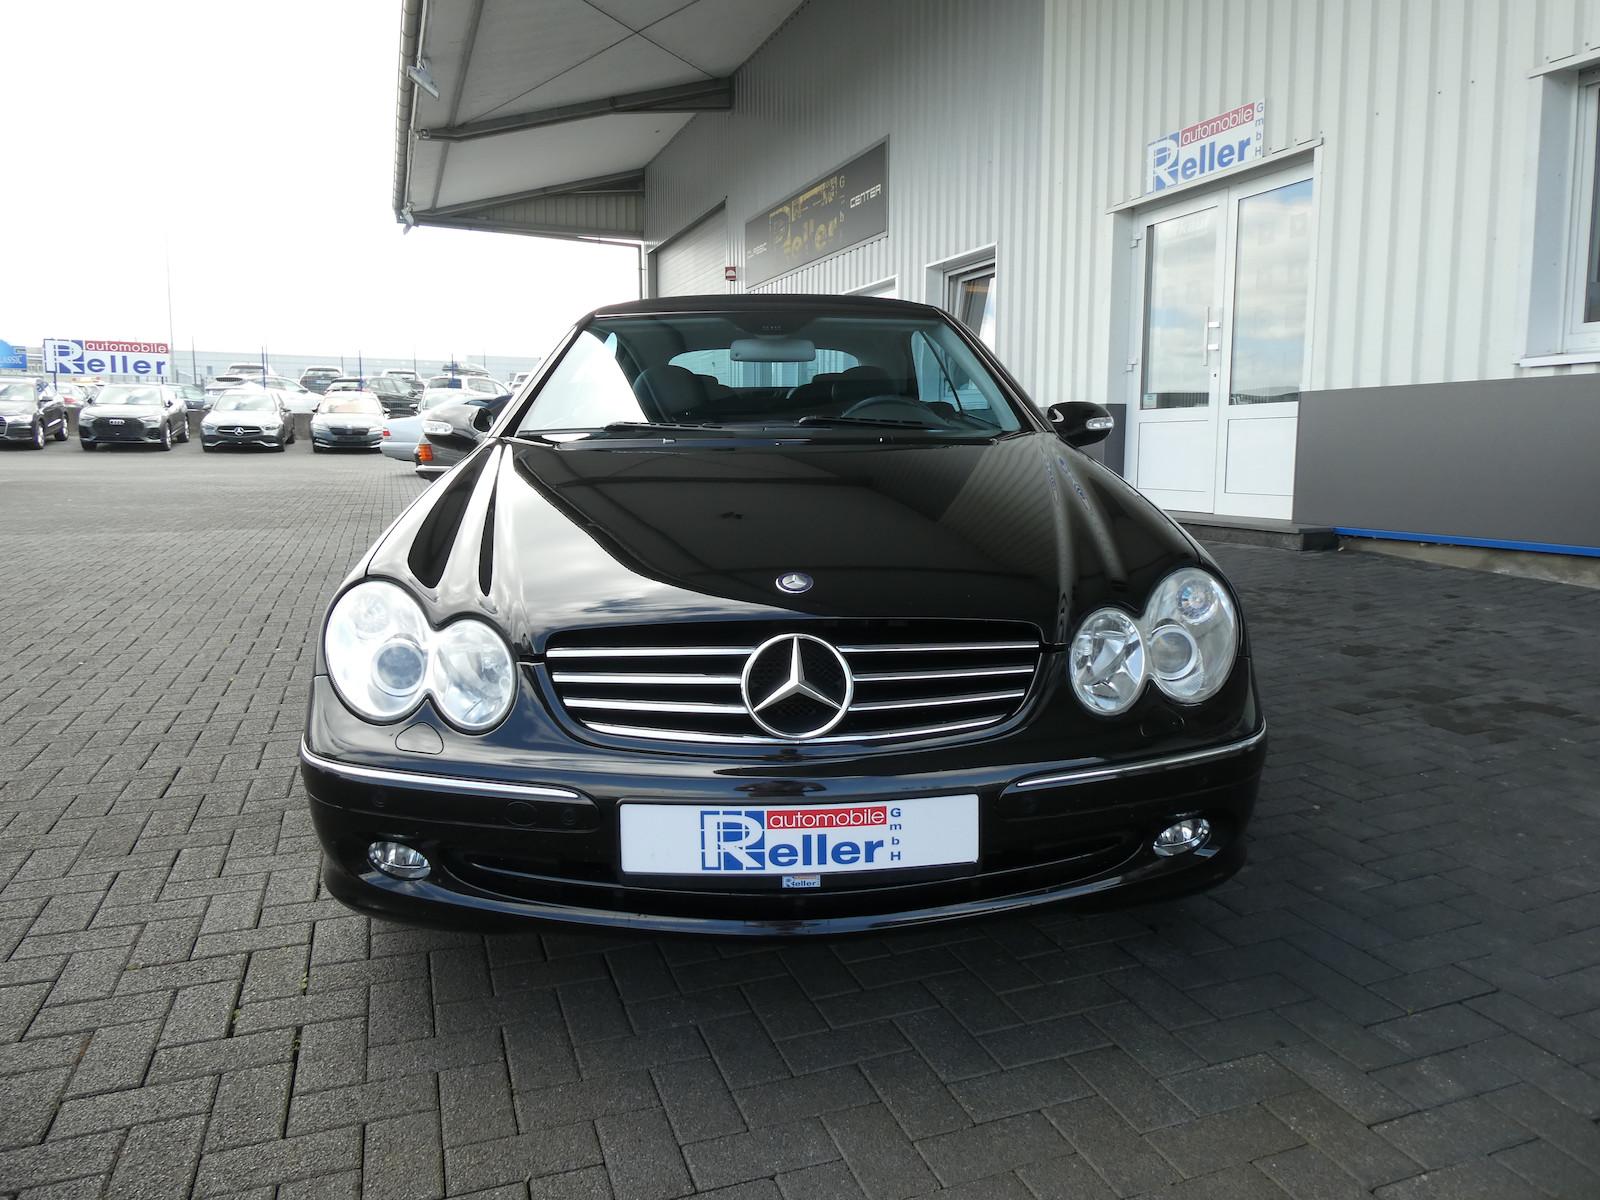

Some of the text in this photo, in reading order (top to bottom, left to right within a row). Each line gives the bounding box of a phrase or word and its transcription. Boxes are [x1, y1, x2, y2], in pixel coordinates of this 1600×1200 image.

[1182, 107, 1253, 145] automobile
[1146, 136, 1251, 194] Reller
[850, 184, 882, 208] CENTER
[44, 339, 166, 374] Reller
[86, 341, 167, 353] automobile
[769, 808, 885, 829] automobile
[890, 807, 901, 861] GmbH
[701, 811, 884, 870] Reller
